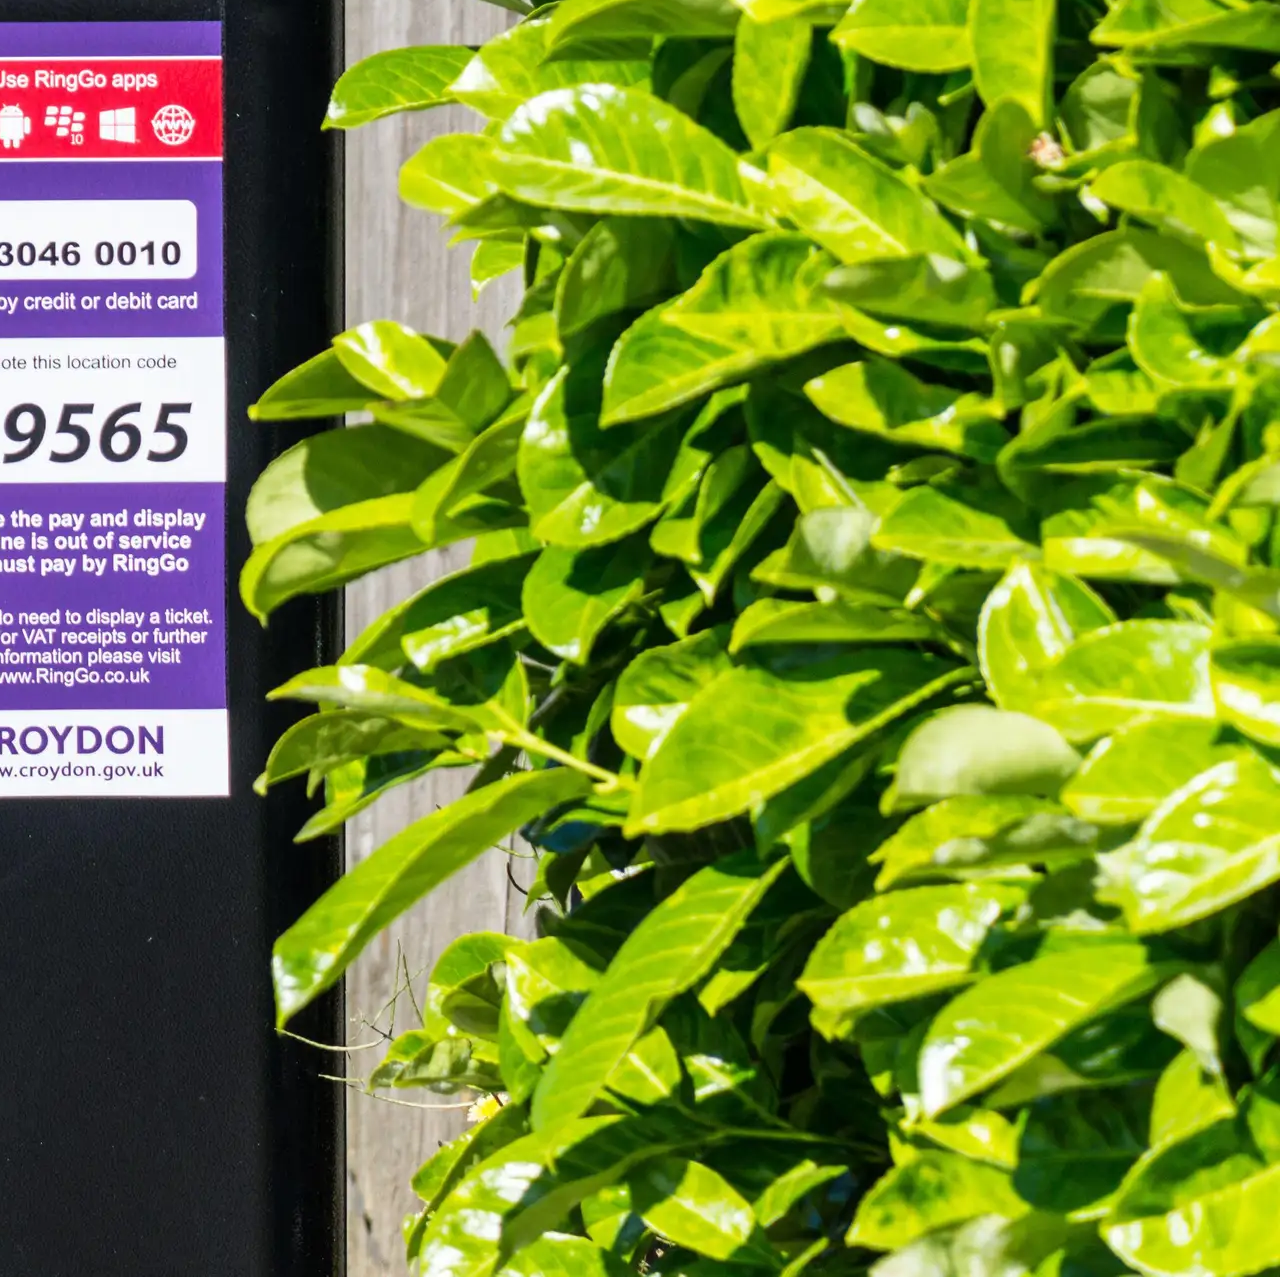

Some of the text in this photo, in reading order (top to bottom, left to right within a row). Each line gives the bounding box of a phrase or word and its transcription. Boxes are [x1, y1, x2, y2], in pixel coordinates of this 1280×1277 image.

[34, 69, 108, 93] RingGo
[111, 73, 159, 92] apps
[71, 134, 83, 145] 10
[95, 241, 181, 266] 0010
[23, 291, 76, 310] credit
[80, 295, 101, 310] or
[105, 291, 153, 310] debit
[157, 291, 198, 310] card
[32, 355, 62, 370] this
[67, 354, 131, 370] location
[136, 354, 177, 369] code
[10, 509, 43, 528] the
[48, 513, 85, 532] pay
[89, 508, 128, 527] and
[133, 508, 206, 531] display
[31, 531, 49, 550] is
[54, 532, 89, 550] out
[92, 530, 115, 550] of
[118, 530, 192, 550] service
[40, 558, 77, 577] pay
[82, 553, 107, 577] by
[112, 553, 190, 576] RingGo
[18, 608, 61, 625] need
[64, 609, 82, 625] to
[85, 608, 145, 628] display
[149, 611, 161, 625] a
[164, 607, 213, 625] ticket.
[21, 628, 57, 645] VAT
[61, 627, 127, 648] receipts
[131, 631, 150, 644] or
[152, 627, 208, 644] further
[87, 647, 144, 668] please
[147, 647, 181, 664] visit
